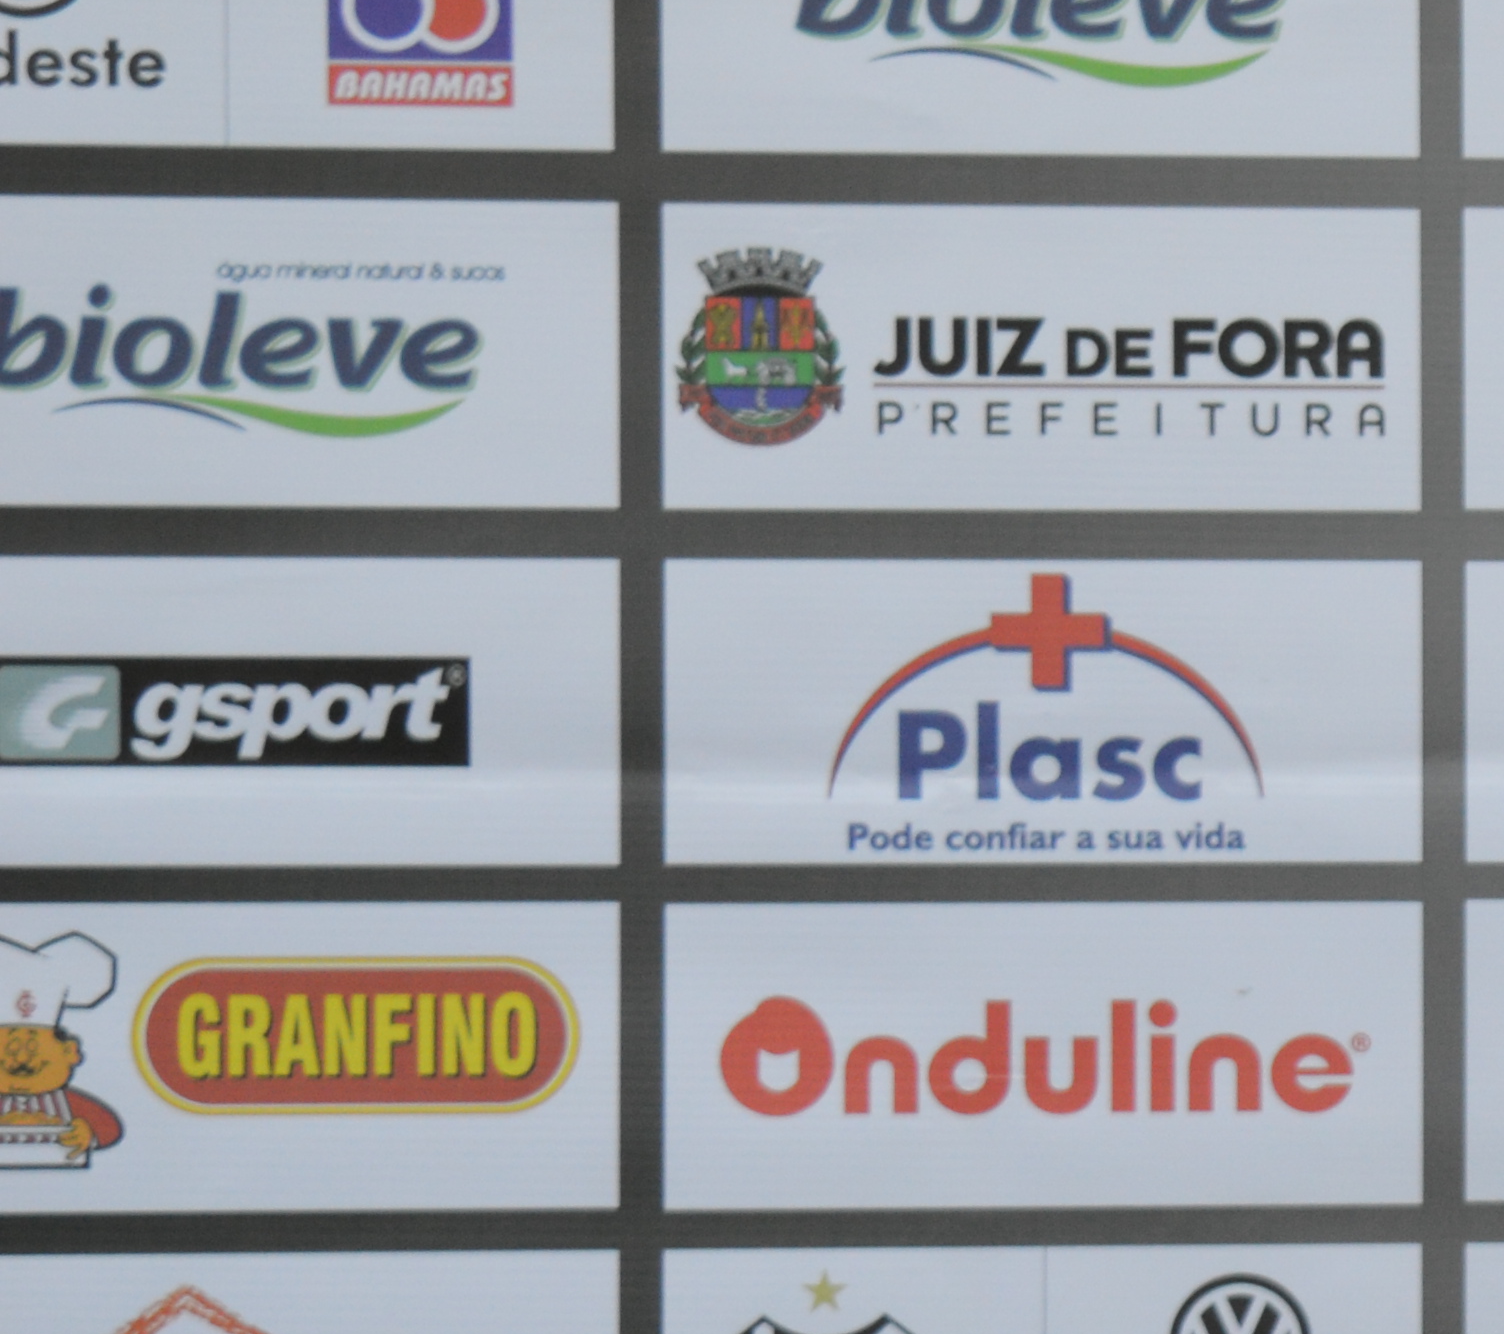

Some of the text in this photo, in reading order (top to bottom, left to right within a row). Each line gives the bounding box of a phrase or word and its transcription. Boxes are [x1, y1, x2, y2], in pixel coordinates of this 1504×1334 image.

[333, 67, 508, 104] BAHAMAS
[0, 284, 479, 391] bioleve
[873, 317, 1384, 379] JUIZ DE FORA
[877, 400, 1385, 437] PREFEITURA
[132, 669, 450, 758] gsport
[897, 701, 1201, 801] Plasc
[847, 822, 1246, 851] Pode confiar a sua vida
[176, 992, 538, 1080] GRANFINO
